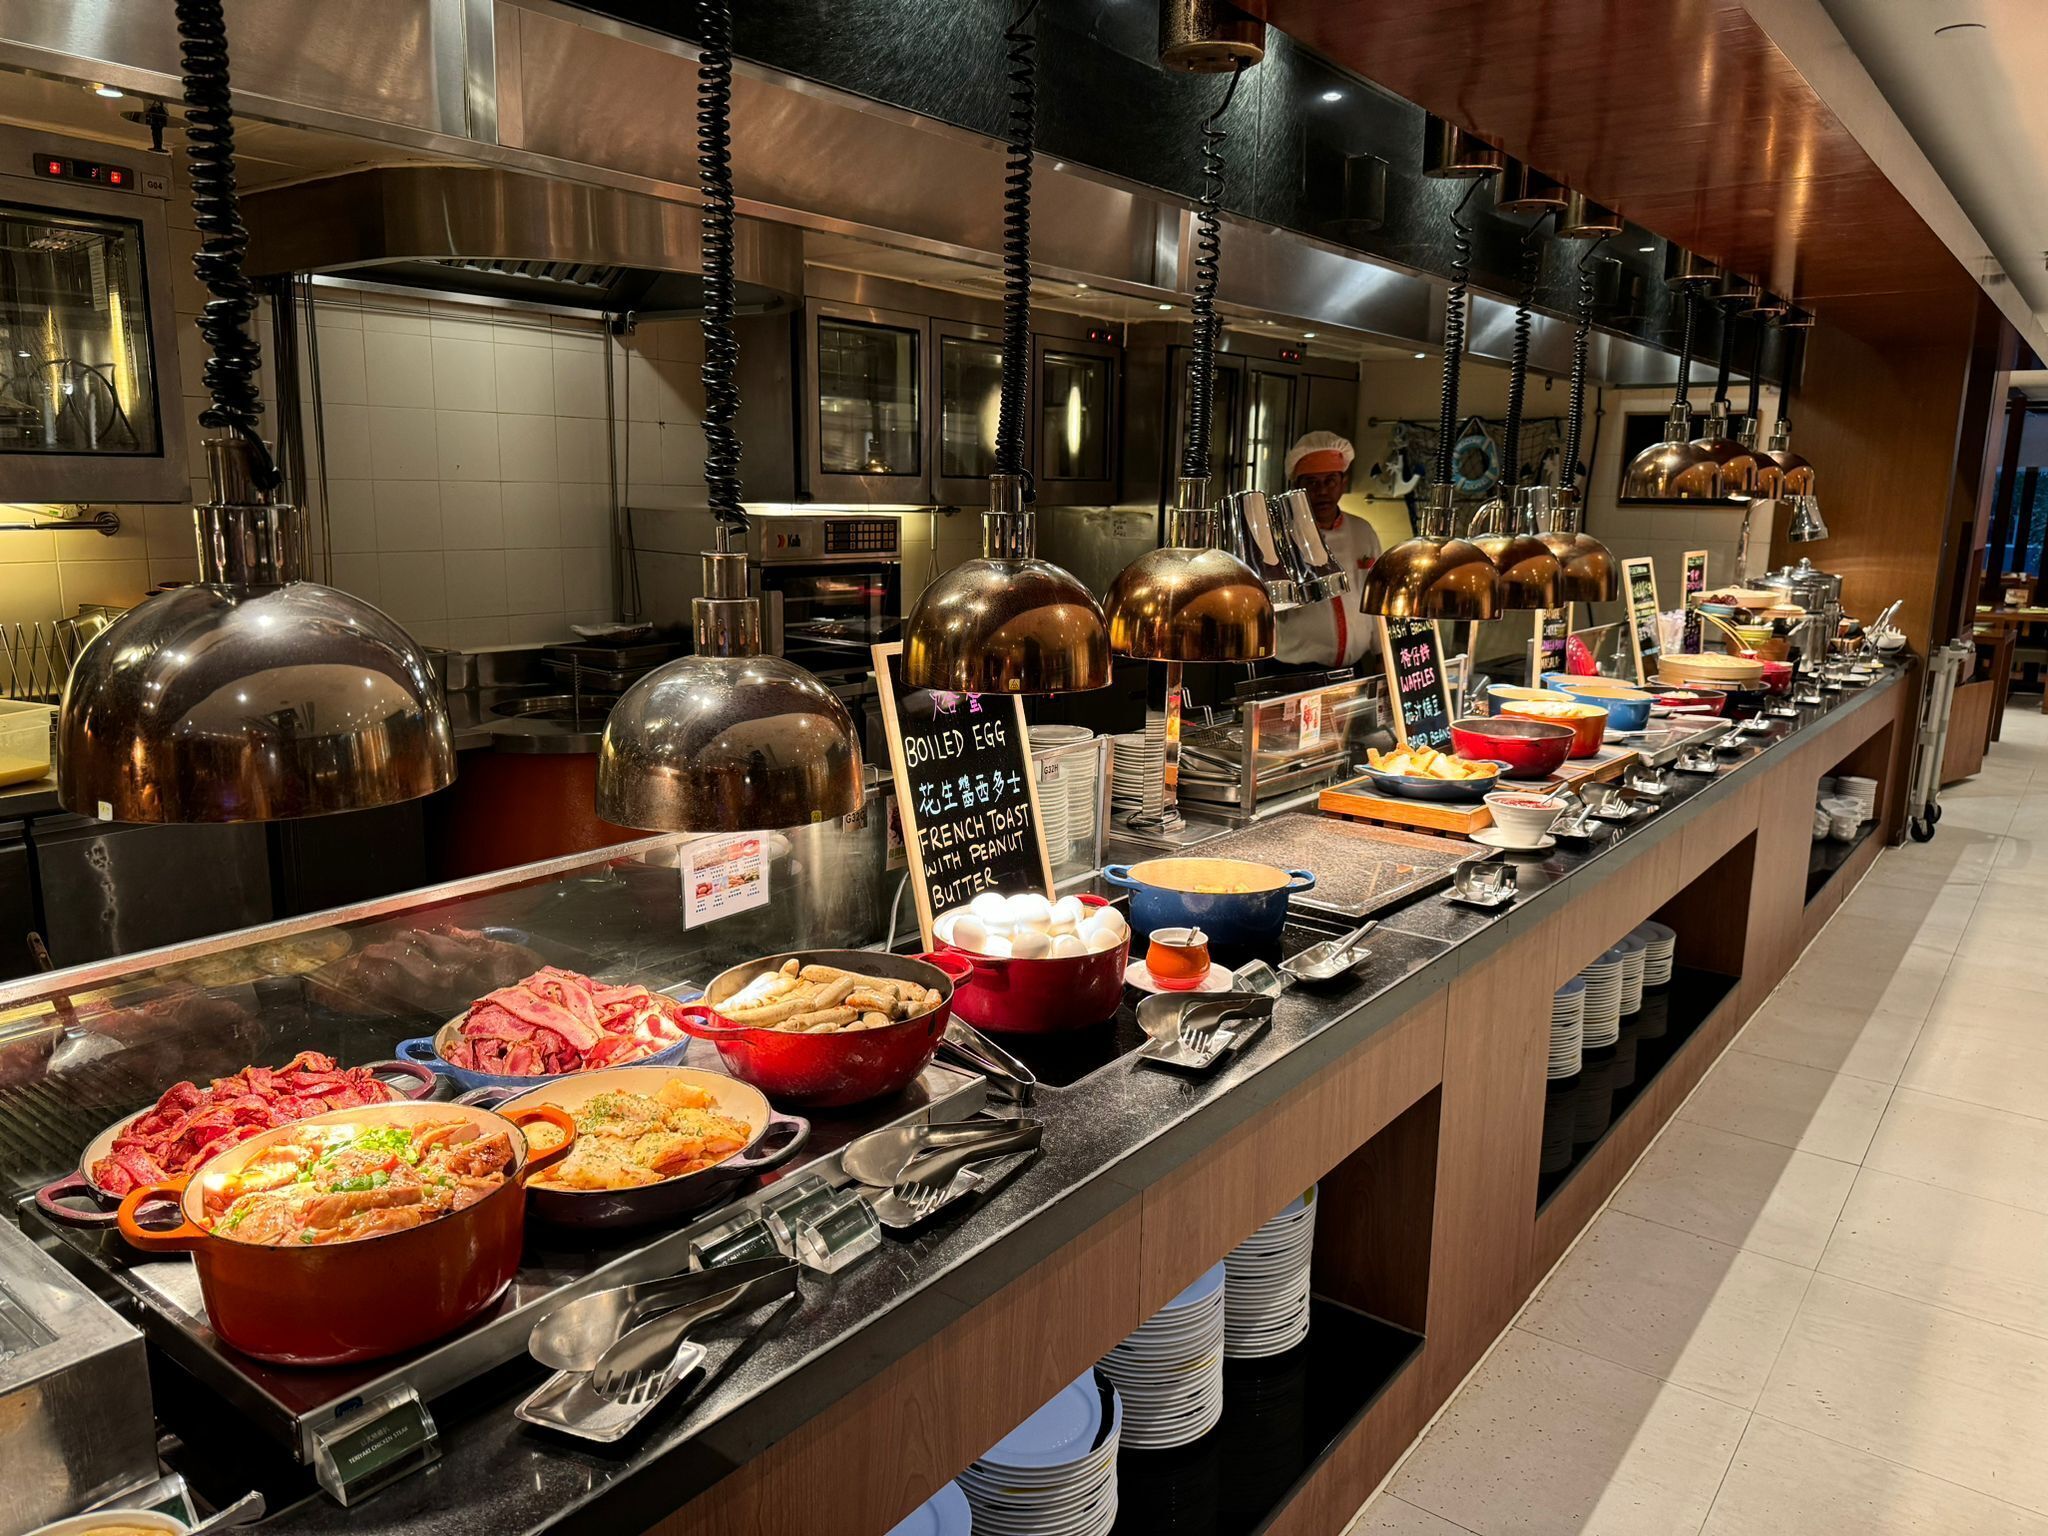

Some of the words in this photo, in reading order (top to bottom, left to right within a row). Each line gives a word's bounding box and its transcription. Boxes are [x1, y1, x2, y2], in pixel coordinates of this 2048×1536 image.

[147, 180, 163, 191] G04
[1400, 667, 1435, 693] WAFFLES
[904, 729, 964, 768] BOILED
[972, 719, 1007, 751] EGG
[1430, 727, 1451, 746] BEANS
[917, 813, 984, 856] FRENCH
[986, 803, 1030, 836] TOAST
[925, 852, 962, 878] WITH
[969, 830, 1024, 866] PEANUT
[932, 867, 998, 909] BUTTER
